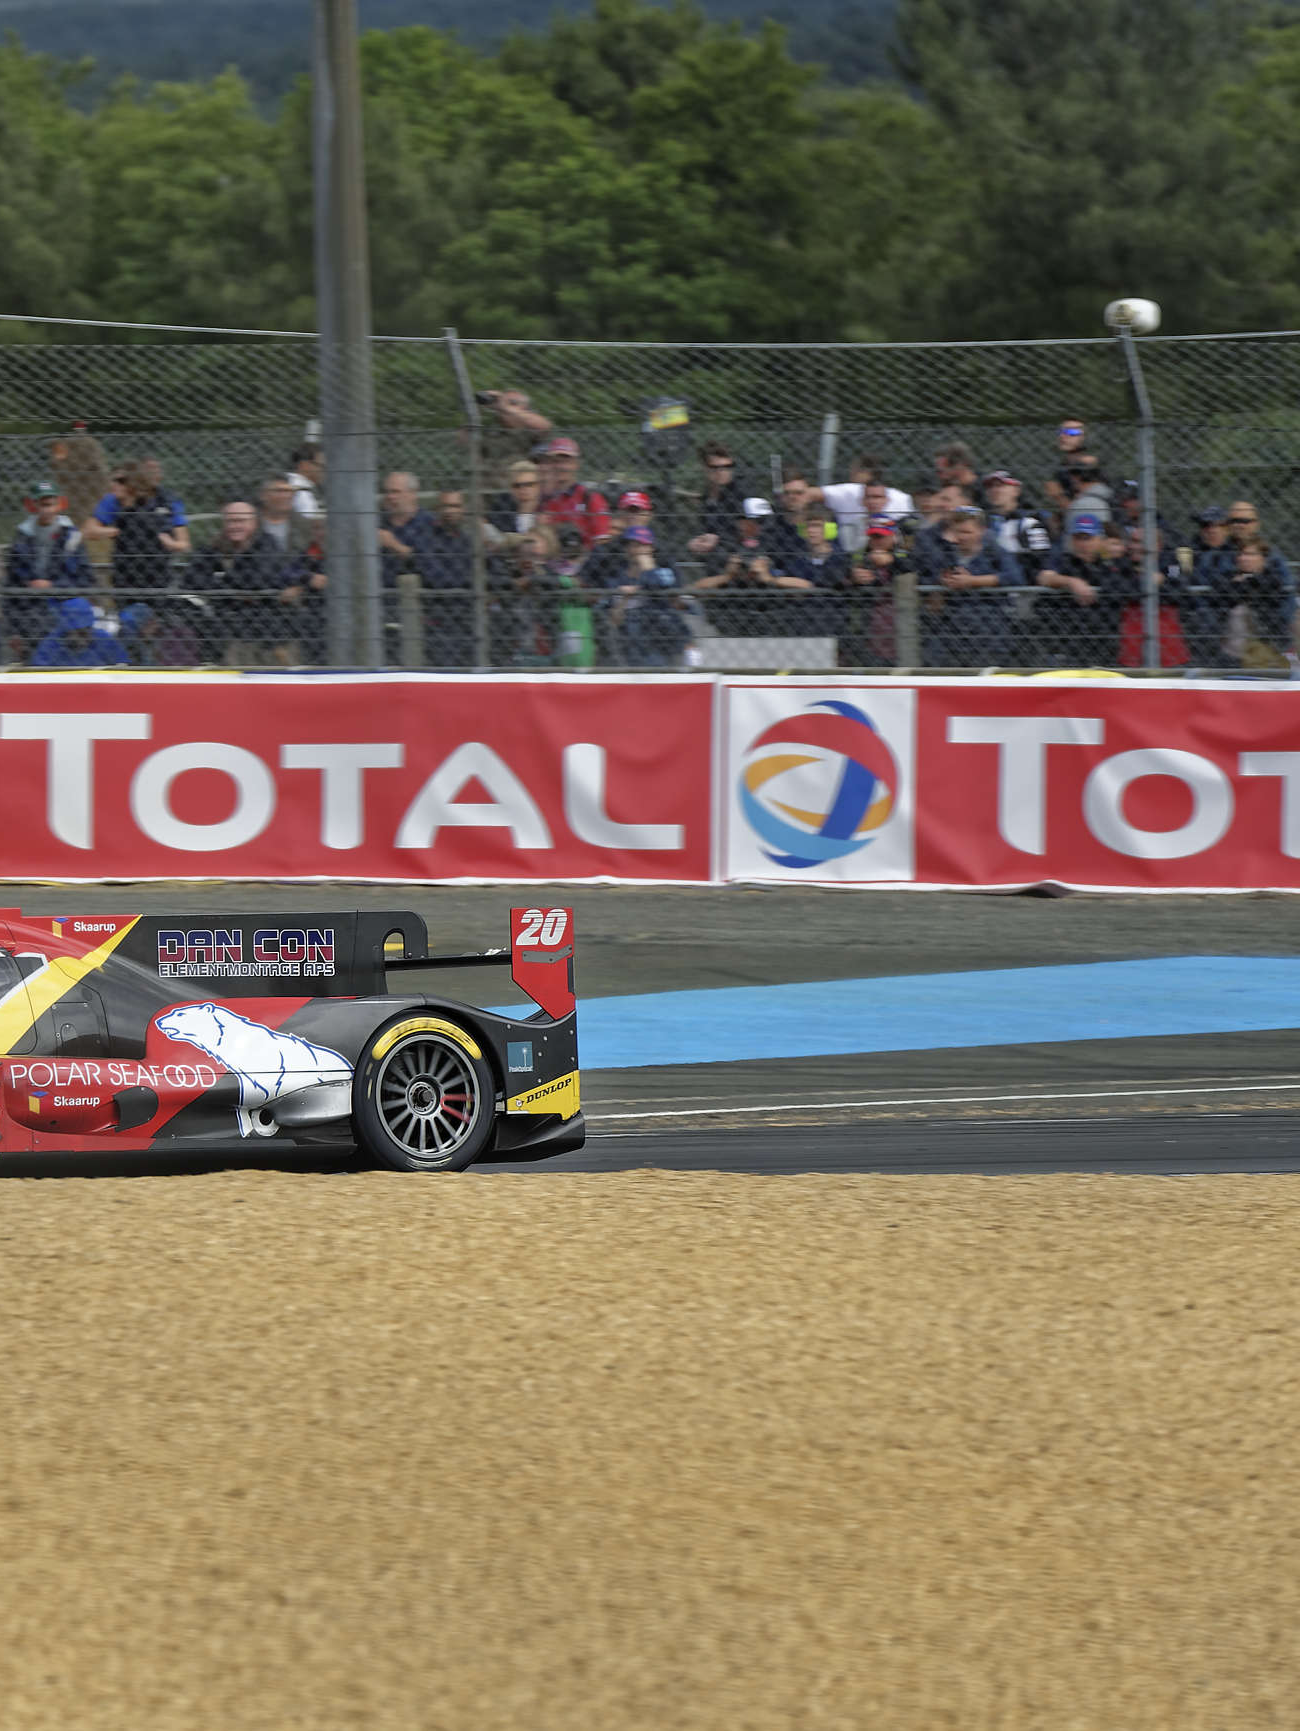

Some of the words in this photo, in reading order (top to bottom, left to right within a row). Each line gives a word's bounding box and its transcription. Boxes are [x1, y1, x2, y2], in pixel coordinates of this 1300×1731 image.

[74, 921, 116, 933] Skaarup
[515, 908, 567, 945] 20
[157, 929, 242, 963] DAN
[253, 929, 335, 963] CON
[159, 963, 300, 977] ELEMENTMONTAGE
[304, 963, 335, 976] APS
[10, 1062, 102, 1088] POLAR
[107, 1063, 216, 1088] SEAFOOD
[53, 1095, 100, 1107] Skaarup
[526, 1078, 572, 1104] DUNLOP
